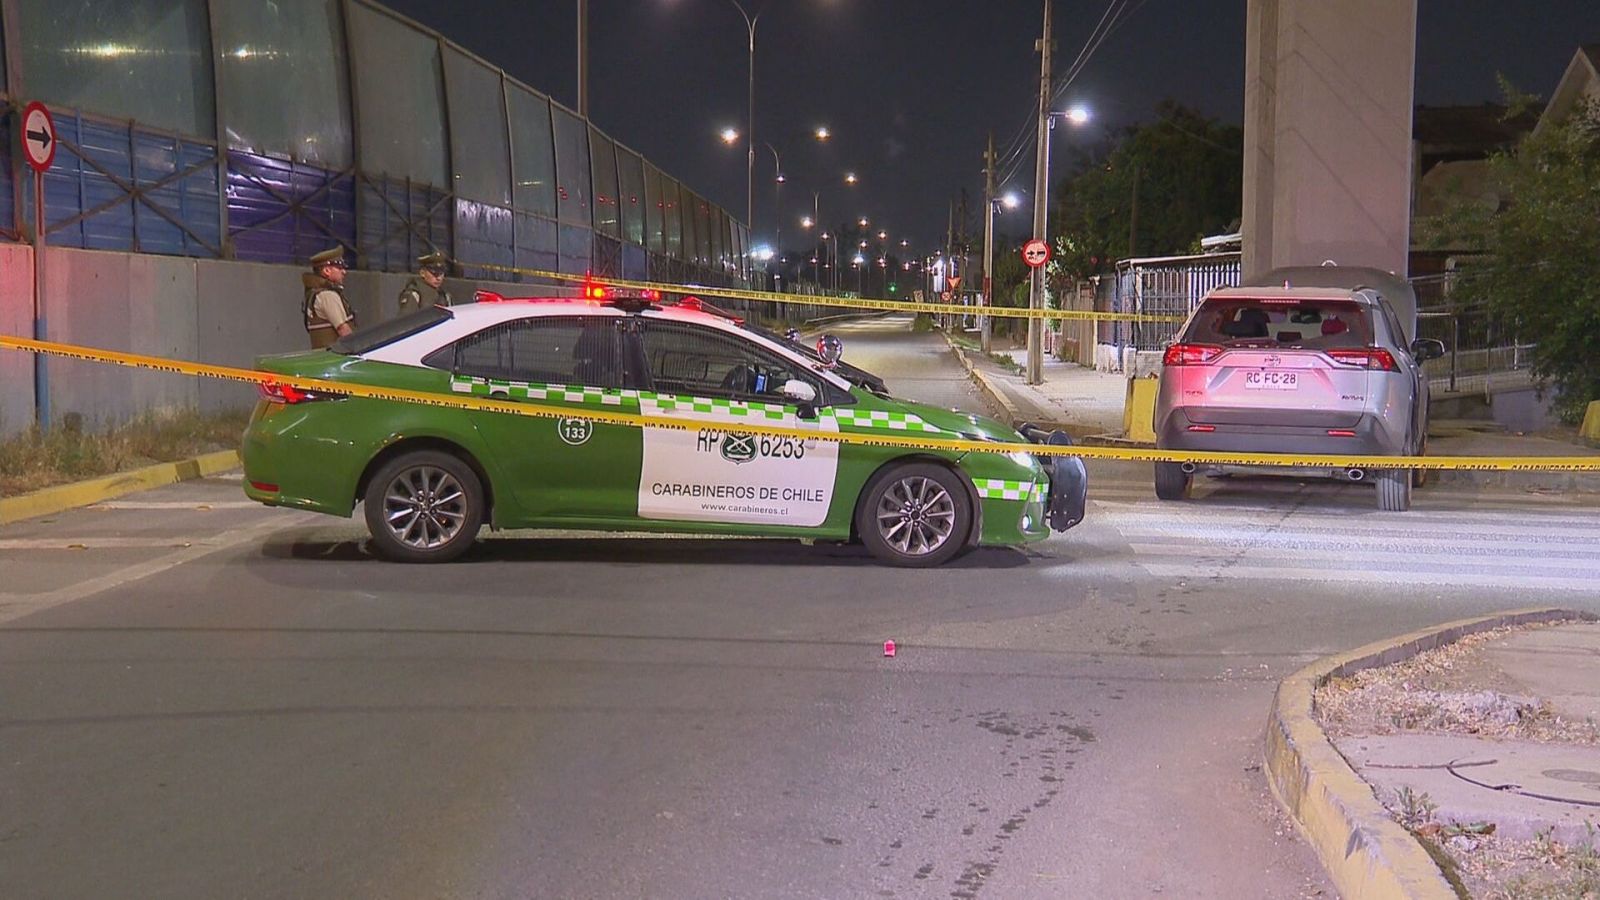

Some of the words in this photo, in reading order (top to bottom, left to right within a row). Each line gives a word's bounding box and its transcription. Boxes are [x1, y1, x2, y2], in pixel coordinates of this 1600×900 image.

[1246, 372, 1260, 383] RC
[565, 427, 586, 439] 133
[697, 431, 720, 452] RP
[760, 433, 805, 459] 6253
[652, 483, 755, 499] CARABINEROS
[759, 487, 779, 500] DE
[782, 488, 824, 502] CHILE
[701, 503, 788, 515] www.carabineros.cl
